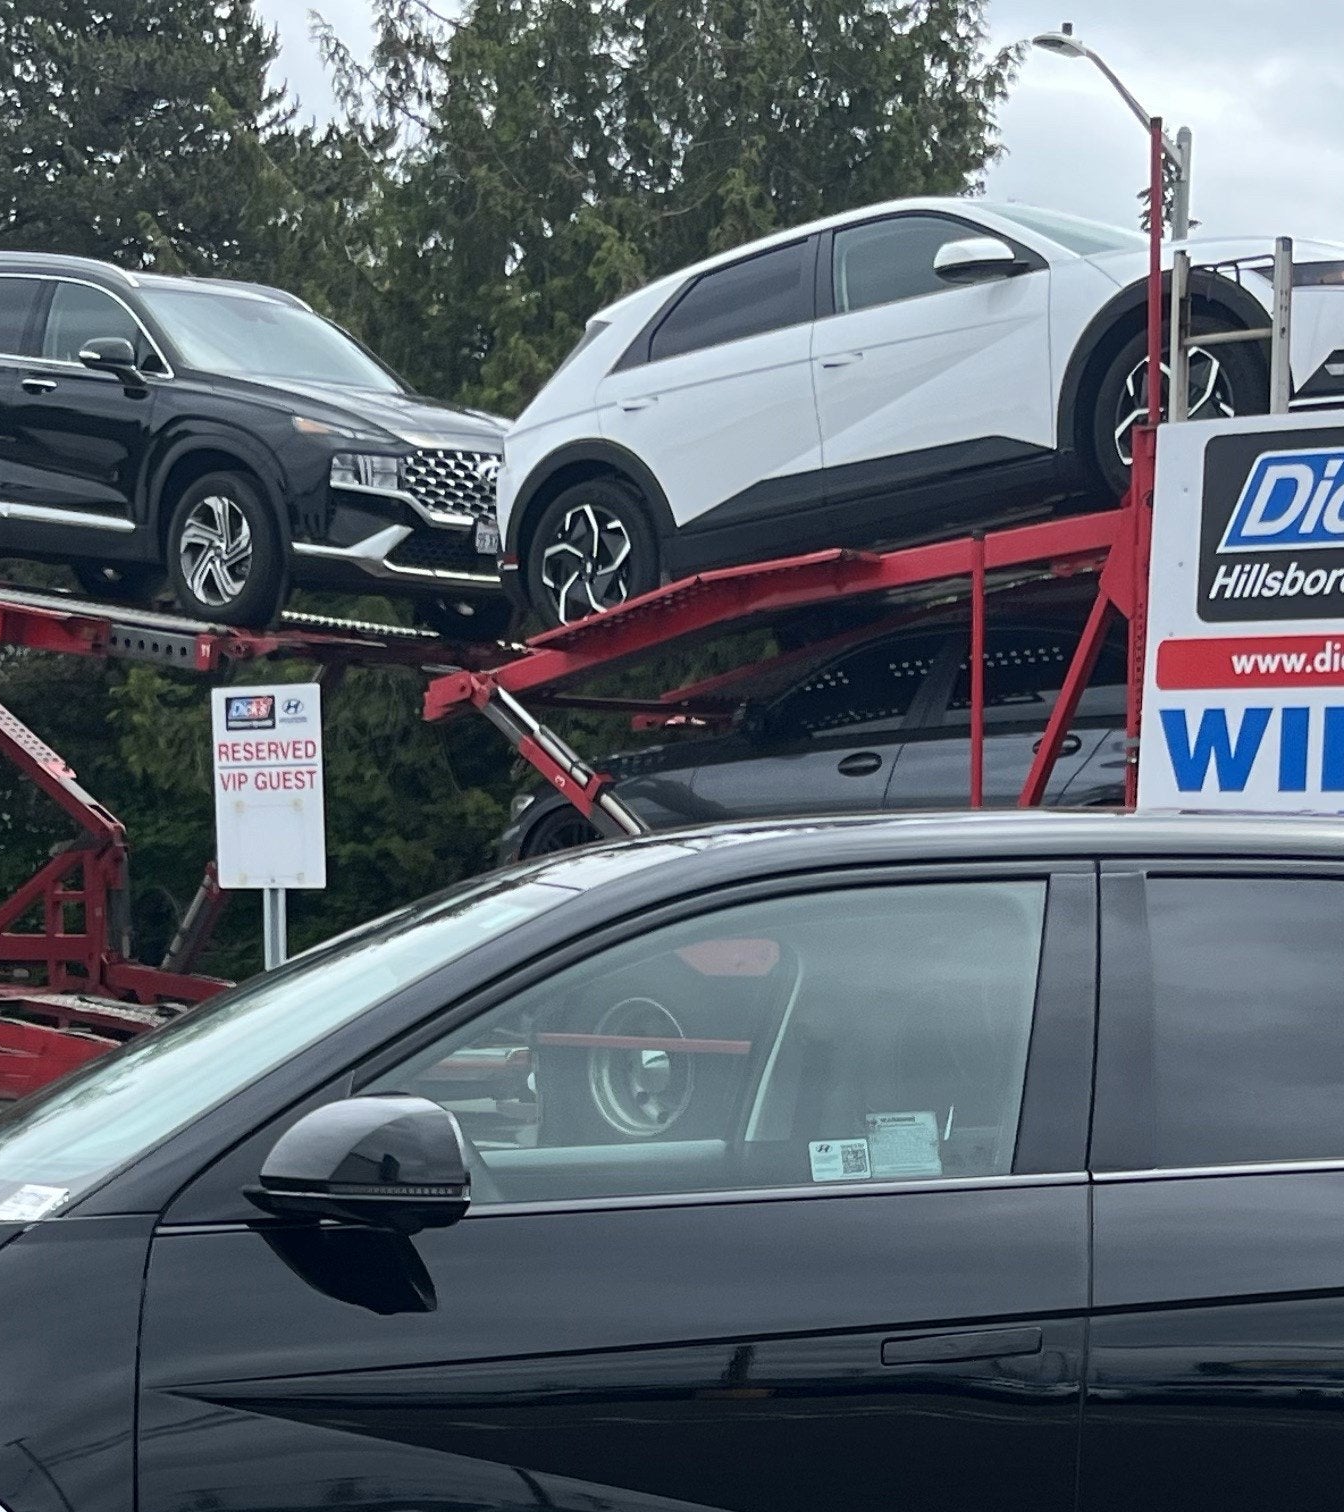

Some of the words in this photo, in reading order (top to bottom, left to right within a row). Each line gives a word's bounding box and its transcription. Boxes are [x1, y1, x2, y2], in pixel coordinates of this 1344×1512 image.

[217, 740, 317, 762] RESERVED
[219, 773, 249, 792] VIP
[254, 770, 317, 791] GUEST
